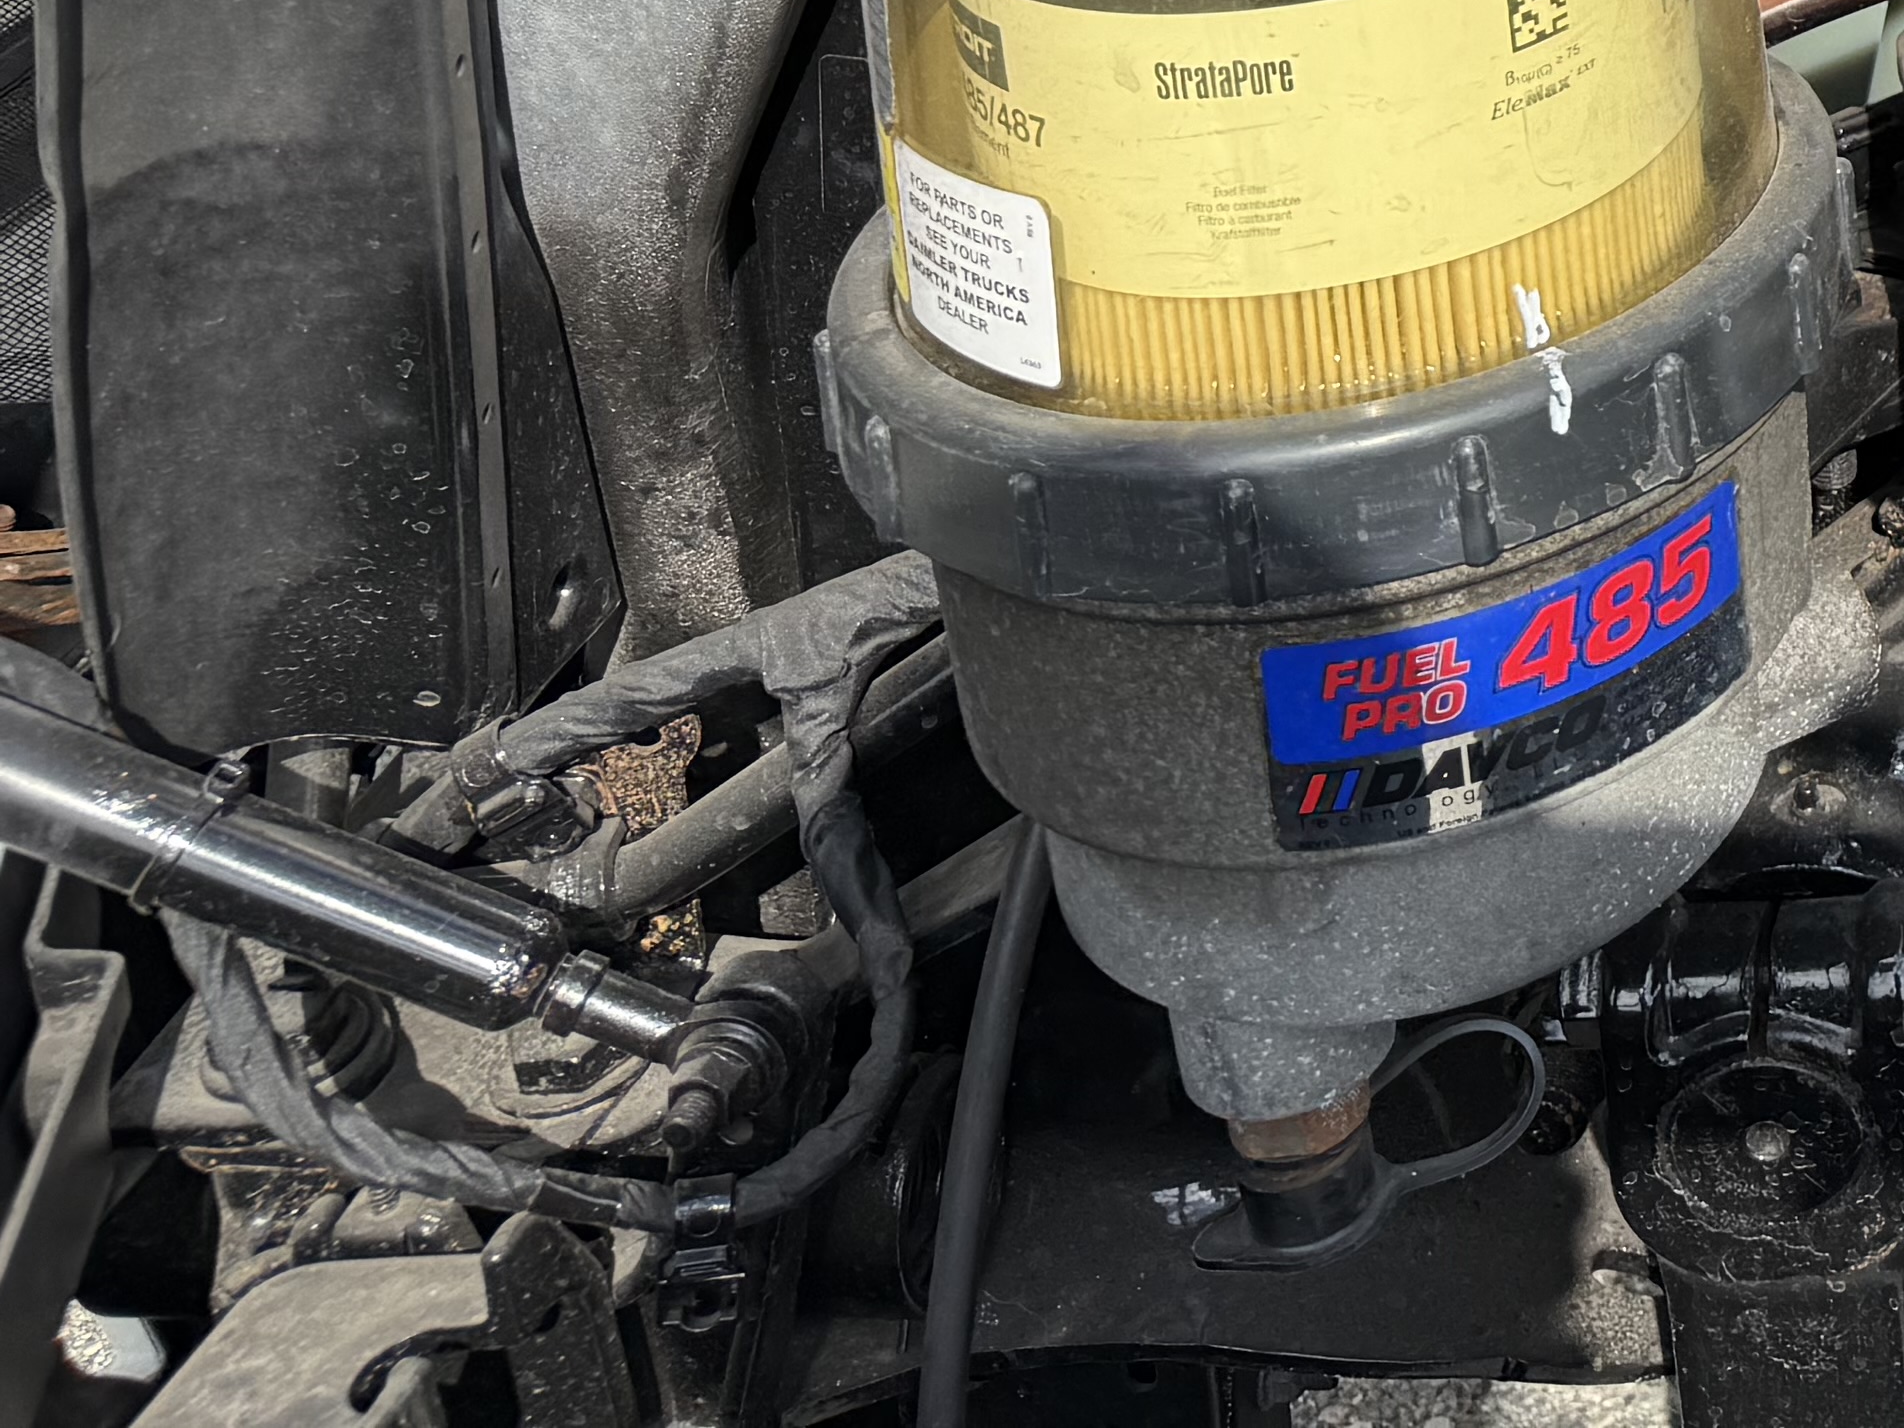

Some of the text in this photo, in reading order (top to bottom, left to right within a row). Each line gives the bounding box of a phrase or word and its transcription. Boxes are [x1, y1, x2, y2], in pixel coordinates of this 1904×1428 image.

[1154, 60, 1294, 100] StrataPore
[909, 172, 931, 197] FOR
[934, 188, 977, 220] PARTS
[981, 210, 1004, 231] OR
[909, 191, 1013, 254] REPLACEMENTS
[1186, 201, 1213, 213] Filtro
[1216, 201, 1231, 212] de
[1198, 215, 1225, 226] Filtro
[907, 230, 1030, 304] DAIMLER TRUCKS
[926, 225, 992, 270] SEE YOUR
[911, 253, 1028, 326] NORTH AMERICA
[938, 295, 989, 334] DEALER
[1494, 512, 1714, 695] 485
[1322, 637, 1472, 701] FUEL
[1342, 681, 1467, 741] PRO
[1362, 693, 1606, 808] DAYCO
